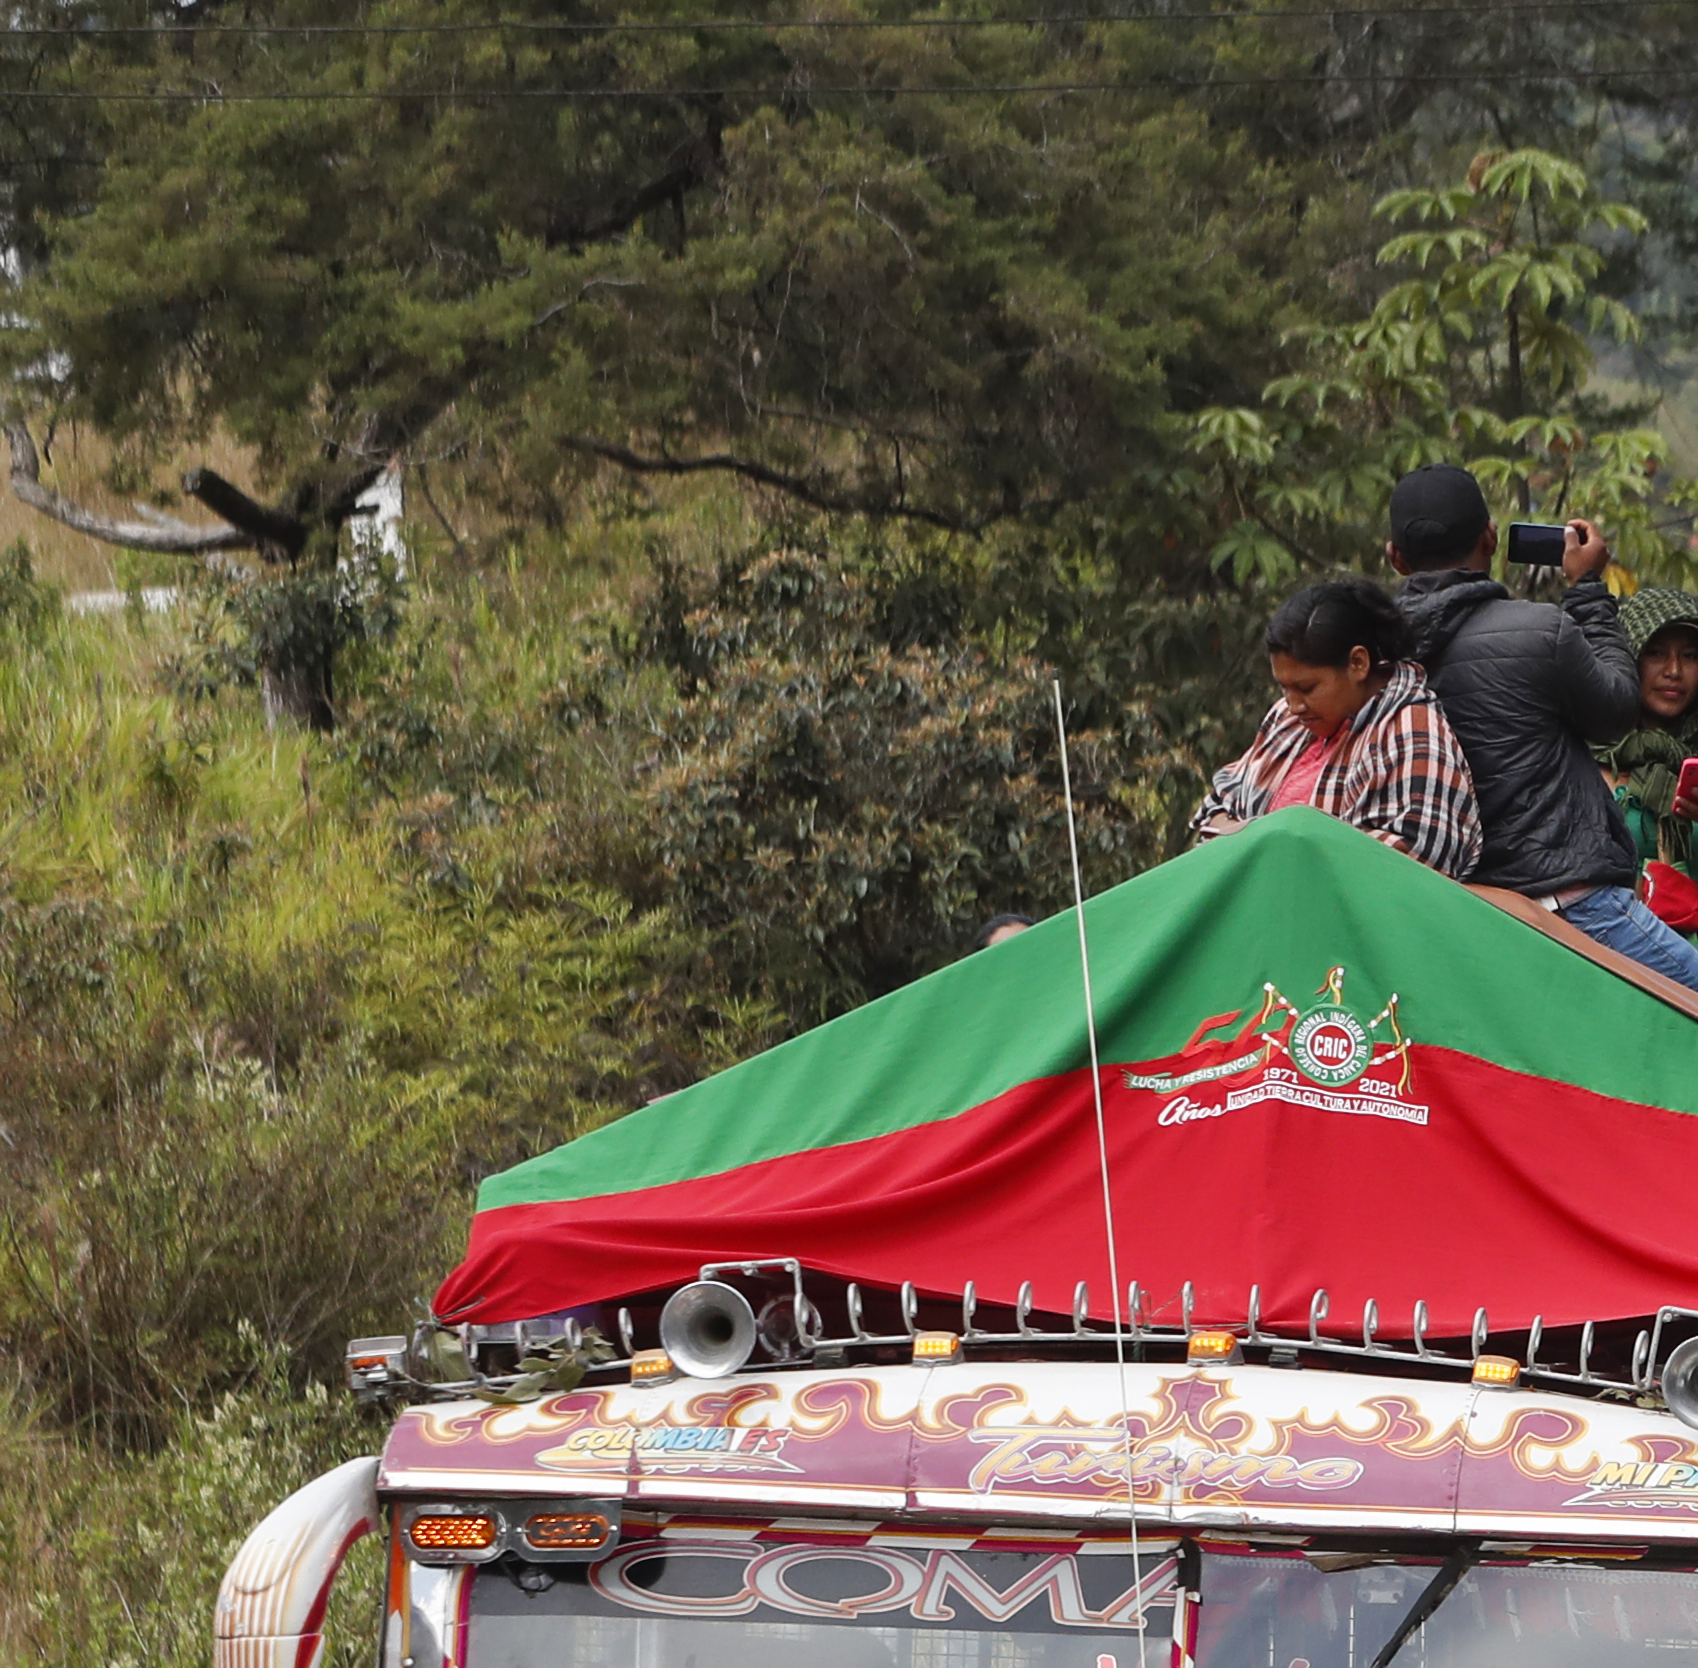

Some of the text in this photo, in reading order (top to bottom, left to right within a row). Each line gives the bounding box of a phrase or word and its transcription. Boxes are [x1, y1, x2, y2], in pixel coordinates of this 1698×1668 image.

[1294, 1011, 1327, 1045] REGIONAL
[1313, 1034, 1348, 1060] CRIC
[1355, 1045, 1367, 1058] DEL
[1131, 1053, 1259, 1090] LUCHA Y RESISTENCIA
[1262, 1068, 1299, 1084] 1971
[1294, 1047, 1328, 1080] CONSEJO
[1331, 1059, 1361, 1081] CAUCA
[1230, 1087, 1265, 1106] UNIDAD
[1265, 1085, 1301, 1102] TIERRA
[1302, 1092, 1351, 1110] CULTURA
[1350, 1099, 1360, 1110] Y
[1358, 1077, 1398, 1098] 2021
[1158, 1096, 1229, 1126] Años
[567, 1427, 788, 1451] COLOMBIA ES
[1590, 1461, 1658, 1487] MI
